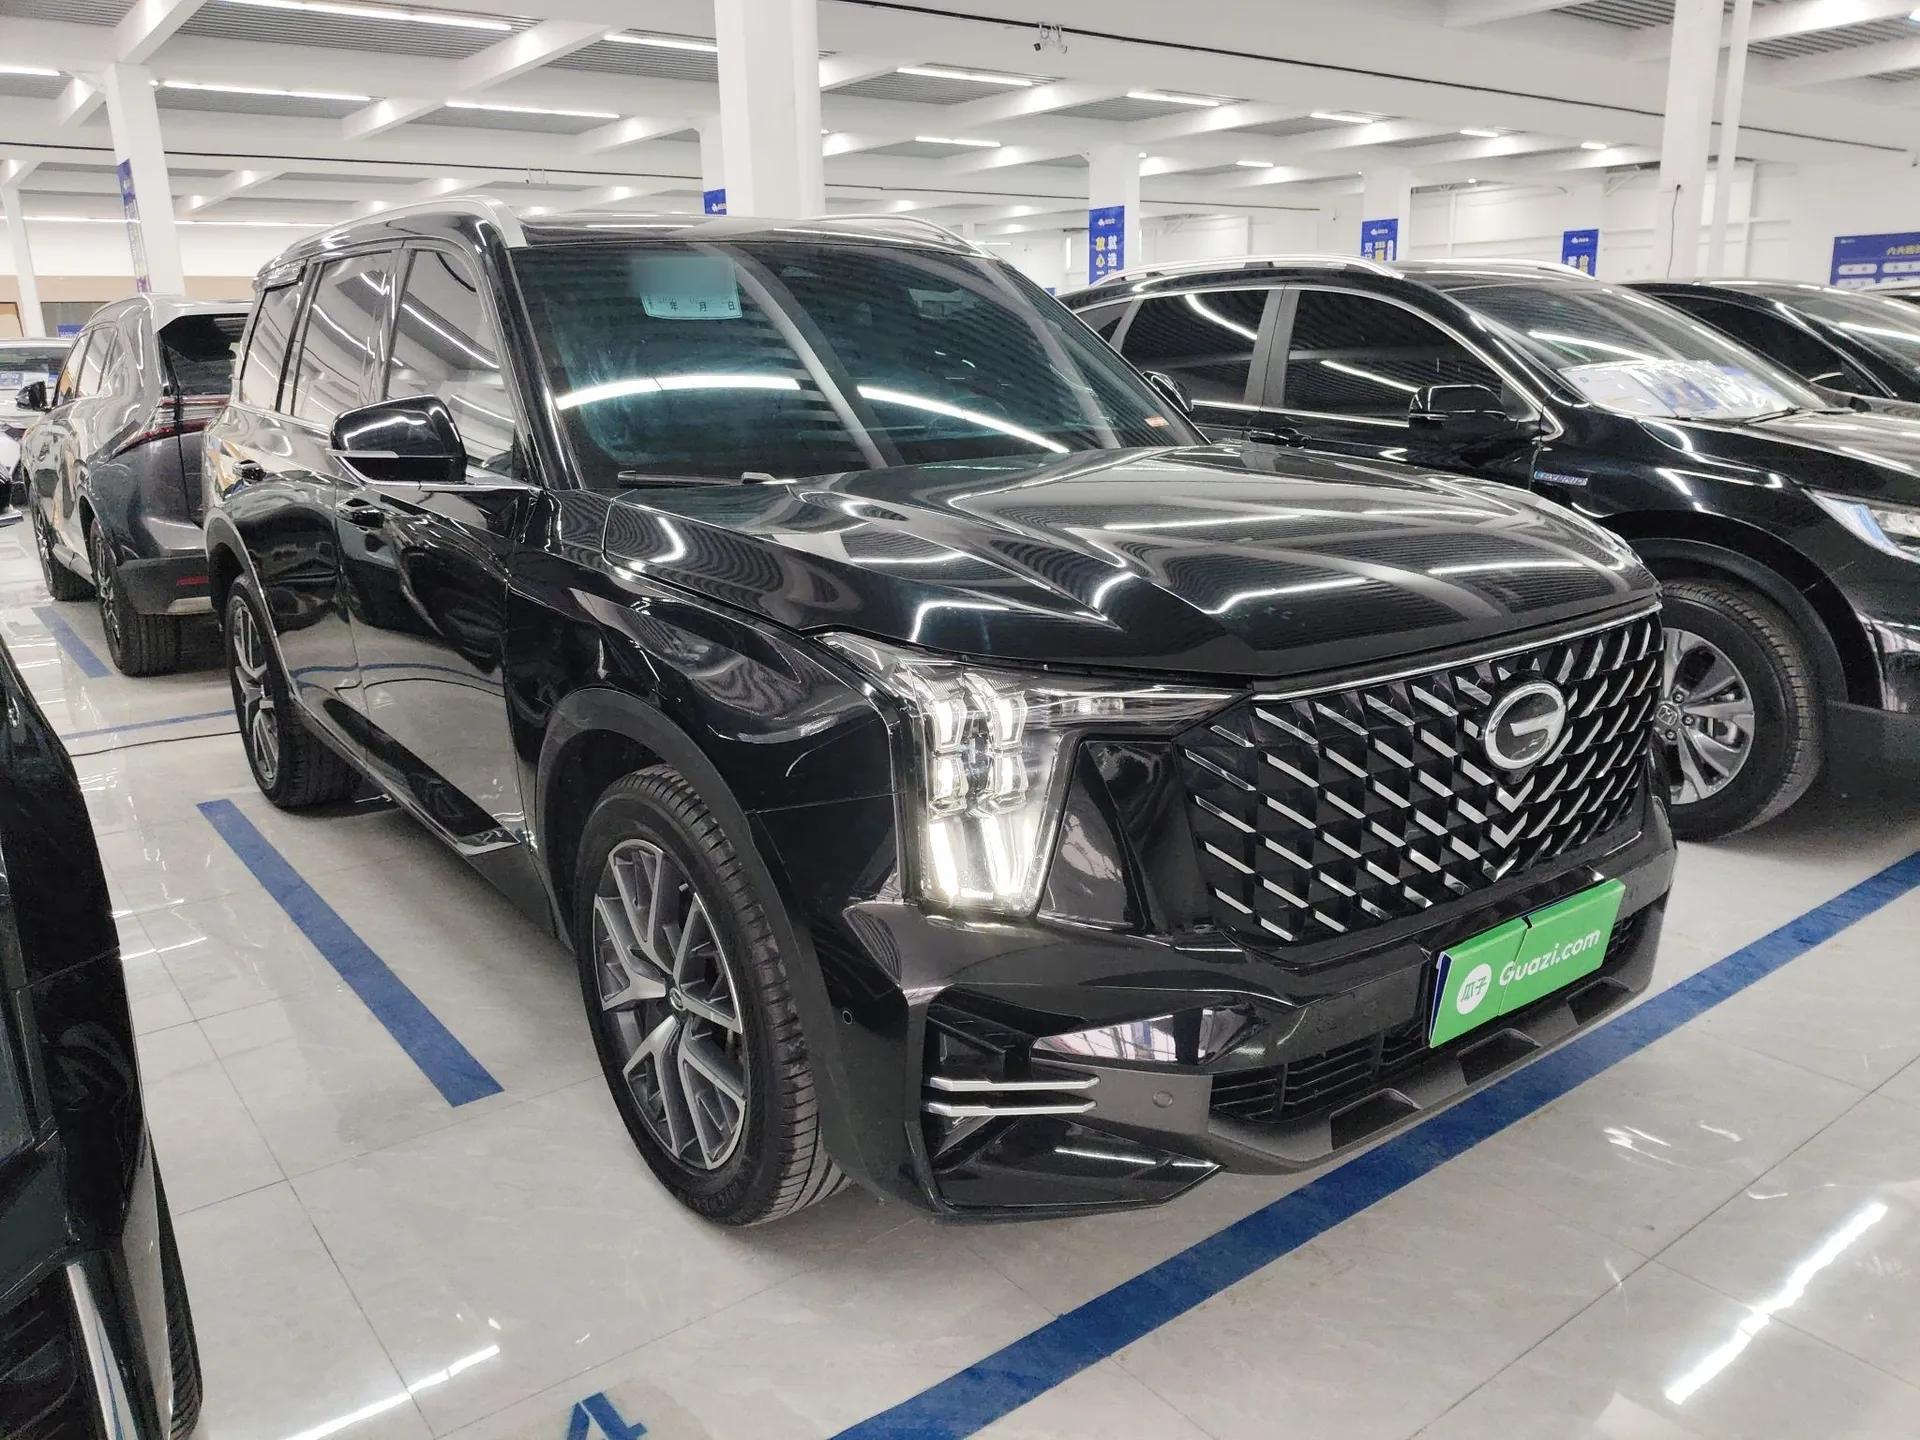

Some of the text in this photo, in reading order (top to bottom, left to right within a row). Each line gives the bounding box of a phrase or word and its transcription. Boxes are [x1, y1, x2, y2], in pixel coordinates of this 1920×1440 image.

[699, 301, 707, 312] 月
[728, 300, 735, 311] 日
[1499, 929, 1601, 986] Guazi.com
[1460, 975, 1488, 1003] 瓜子
